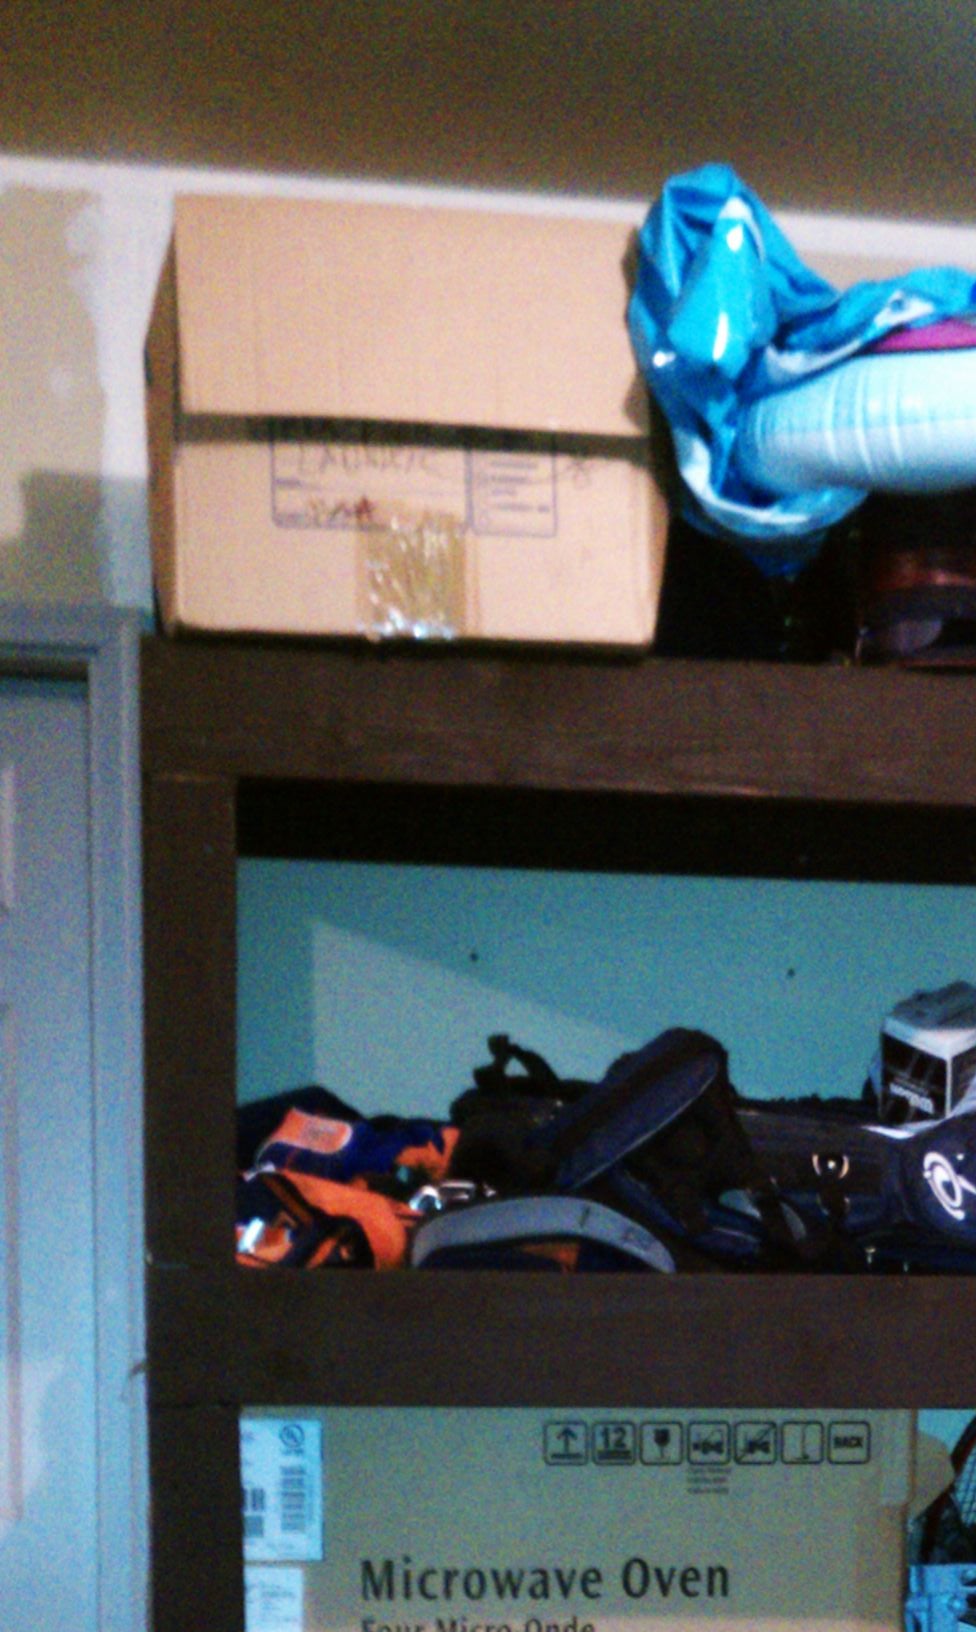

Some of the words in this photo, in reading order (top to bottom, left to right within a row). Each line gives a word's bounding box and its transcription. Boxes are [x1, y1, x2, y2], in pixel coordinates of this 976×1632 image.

[600, 1426, 628, 1450] 12
[361, 1555, 603, 1600] Microwave
[622, 1558, 730, 1599] Oven
